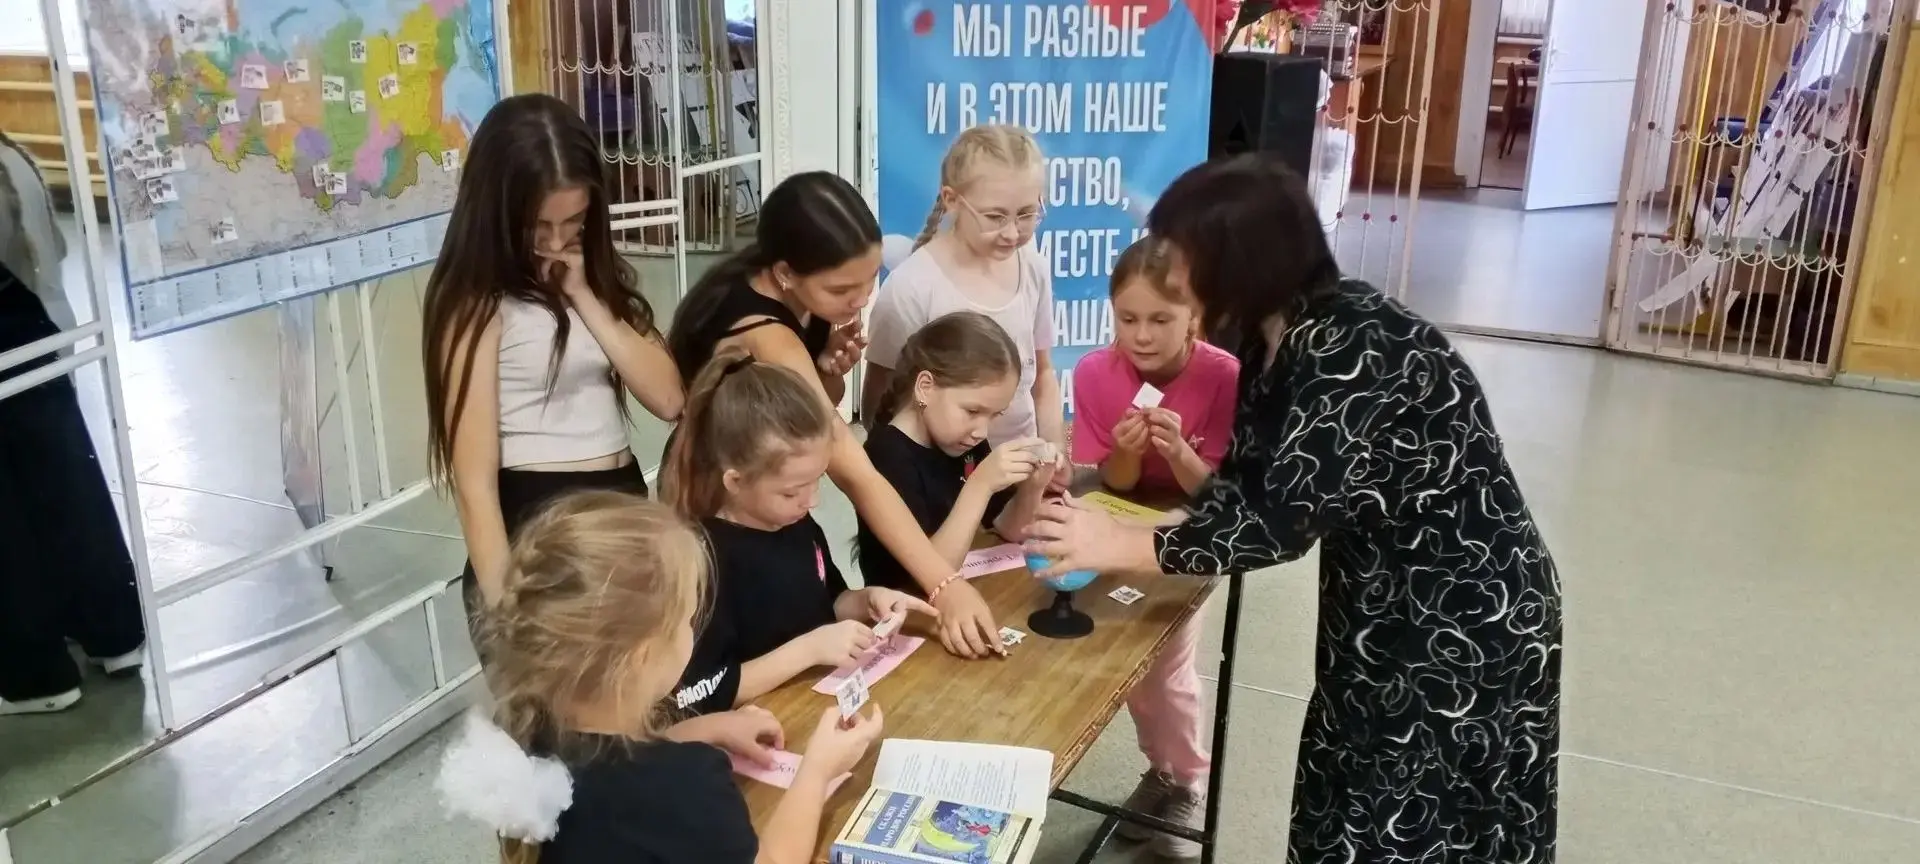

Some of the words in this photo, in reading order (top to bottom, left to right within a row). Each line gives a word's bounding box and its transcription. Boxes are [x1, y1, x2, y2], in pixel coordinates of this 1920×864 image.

[953, 3, 1011, 58] МЫ
[1023, 4, 1148, 58] РАЗНЫЕ
[927, 82, 946, 134] И
[959, 82, 977, 132] В
[988, 82, 1073, 134] ЭТОМ
[1084, 81, 1169, 133] НАШЕ
[1043, 156, 1130, 212] СТВО,
[1033, 228, 1121, 278] МЕСТЕ
[1052, 298, 1116, 347] АША
